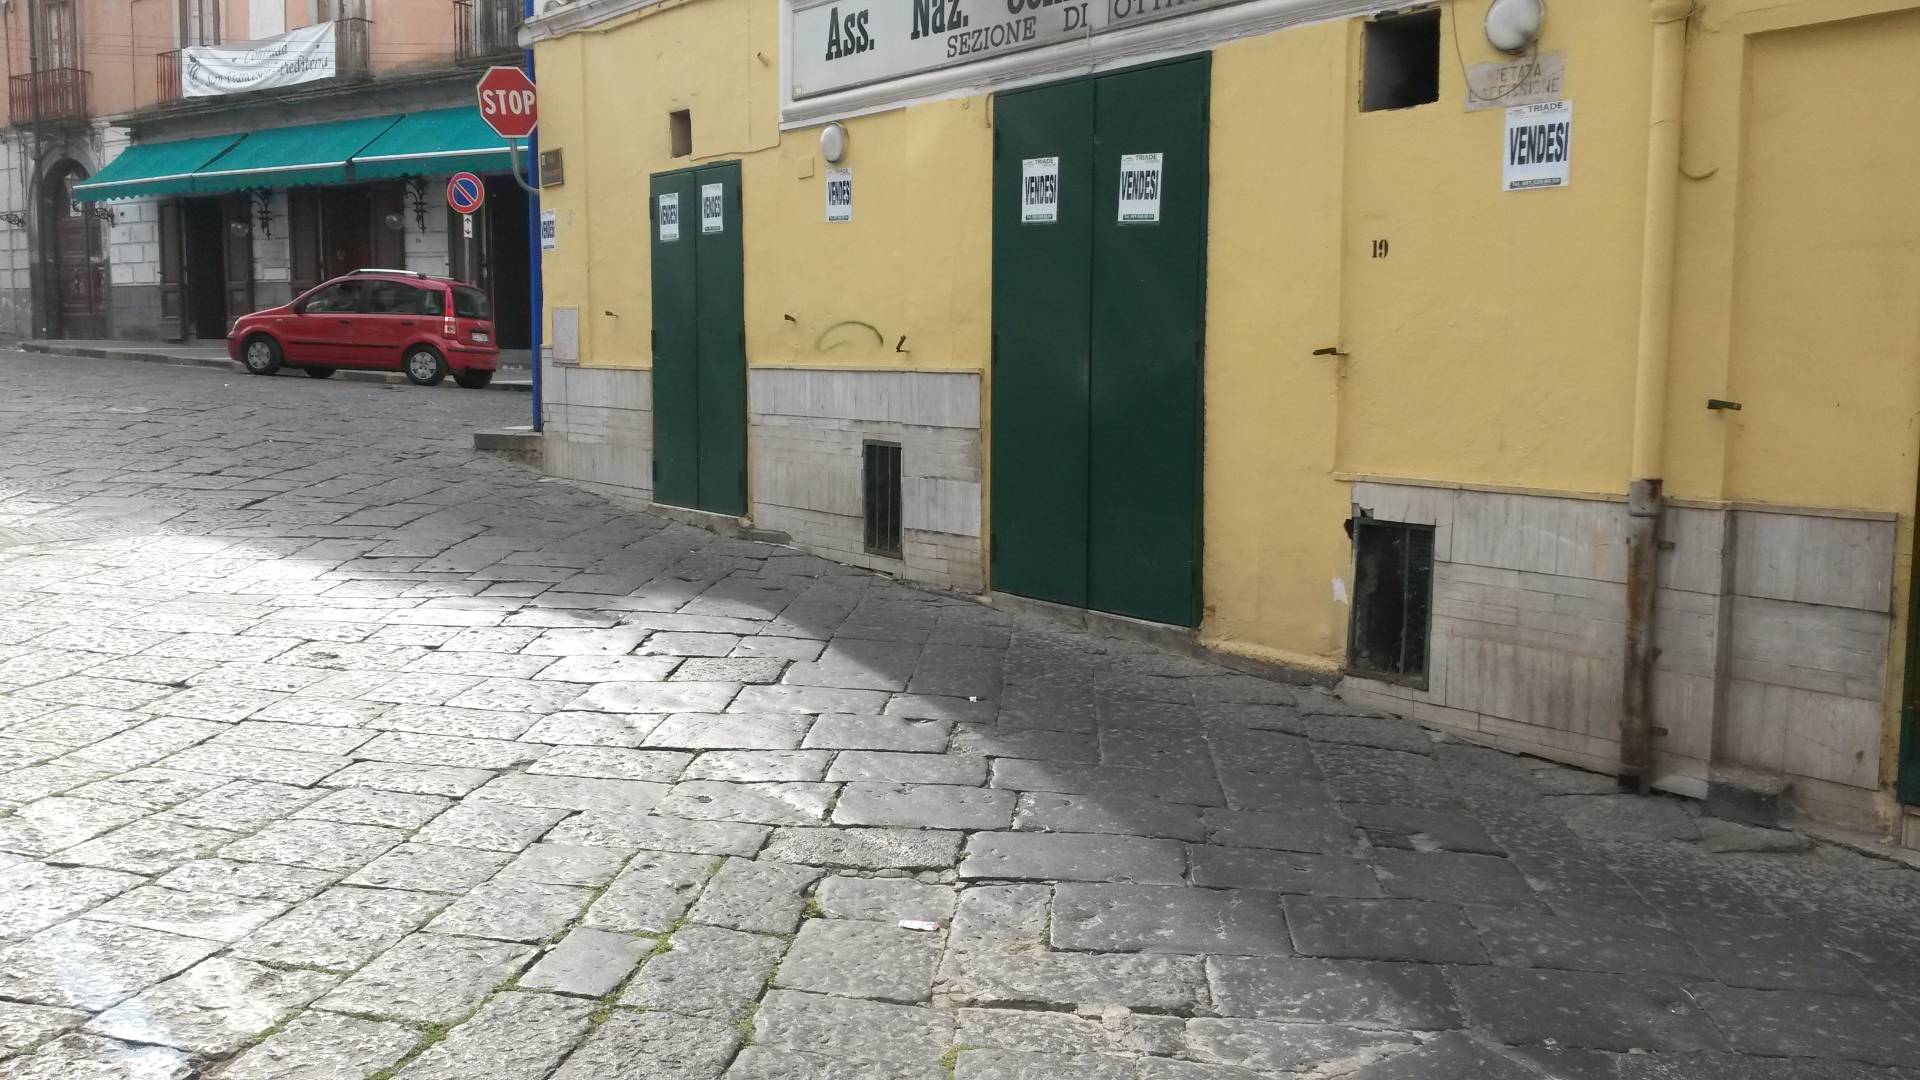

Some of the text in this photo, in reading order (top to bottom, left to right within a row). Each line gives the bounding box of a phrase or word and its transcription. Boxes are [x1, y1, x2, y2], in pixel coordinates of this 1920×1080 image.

[825, 0, 969, 61] Ass. Naz.
[947, 16, 1036, 58] SEZIONE
[1063, 3, 1089, 32] DI
[482, 90, 535, 115] STOP
[1528, 101, 1563, 113] TRIADE
[1510, 122, 1570, 166] VENDESI
[828, 180, 852, 206] VENDESI
[1025, 174, 1057, 205] VENDESI
[1121, 170, 1159, 200] VENDESI
[660, 204, 678, 225] VENDESI
[703, 195, 722, 218] VENDESI
[1372, 239, 1389, 258] 19
